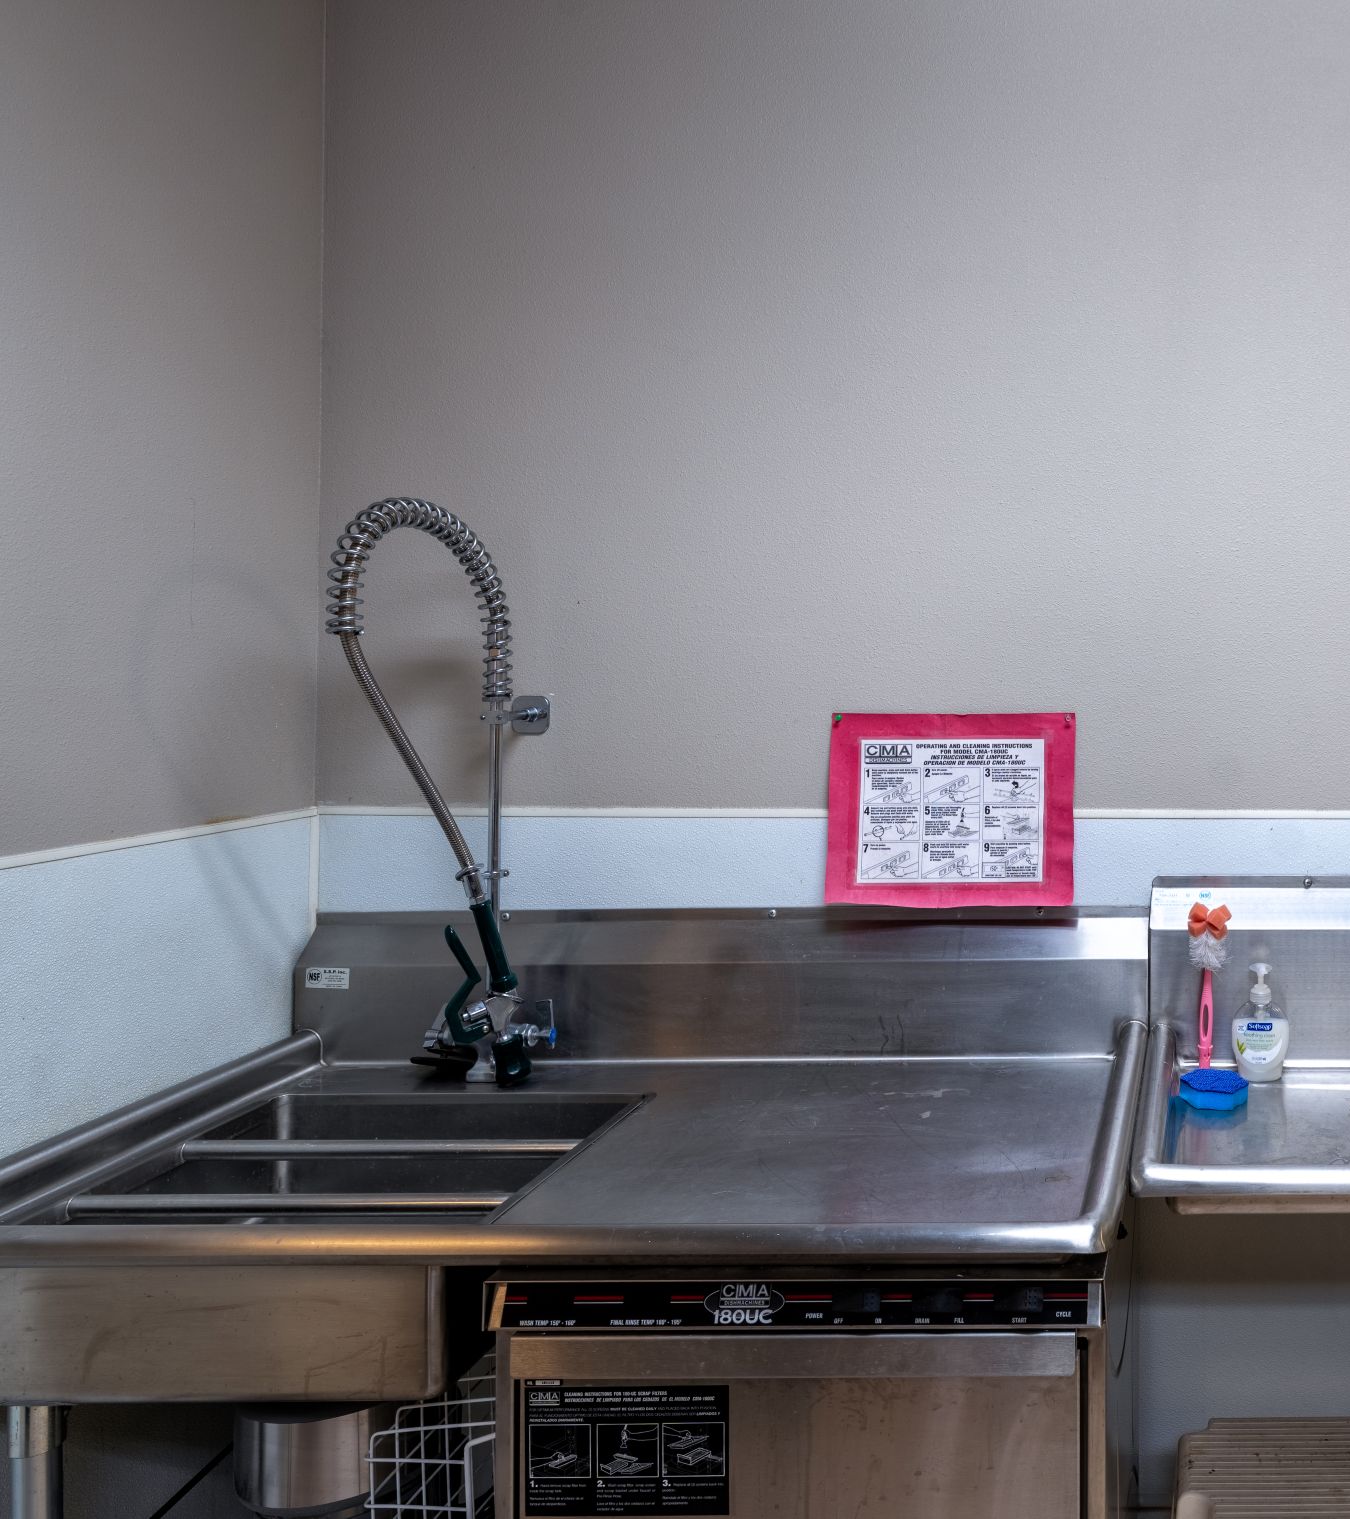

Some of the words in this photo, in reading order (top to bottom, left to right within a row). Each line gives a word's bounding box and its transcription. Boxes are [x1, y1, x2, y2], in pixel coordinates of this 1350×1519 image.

[866, 745, 911, 756] CMA
[866, 769, 870, 777] 1
[924, 768, 931, 777] 2
[984, 768, 991, 777] 3
[864, 806, 870, 815] 4
[924, 806, 931, 815] 5
[984, 805, 991, 815] 6
[863, 844, 869, 853] 7
[923, 843, 929, 852] 8
[984, 843, 990, 852] 9
[309, 972, 321, 981] NSF
[1248, 1023, 1272, 1031] Softsoap
[722, 1284, 769, 1297] CMA
[713, 1309, 773, 1324] 180UC
[530, 1392, 559, 1400] CMA
[529, 1480, 539, 1488] 1.
[596, 1479, 606, 1488] 2.
[662, 1479, 671, 1487] 3.
